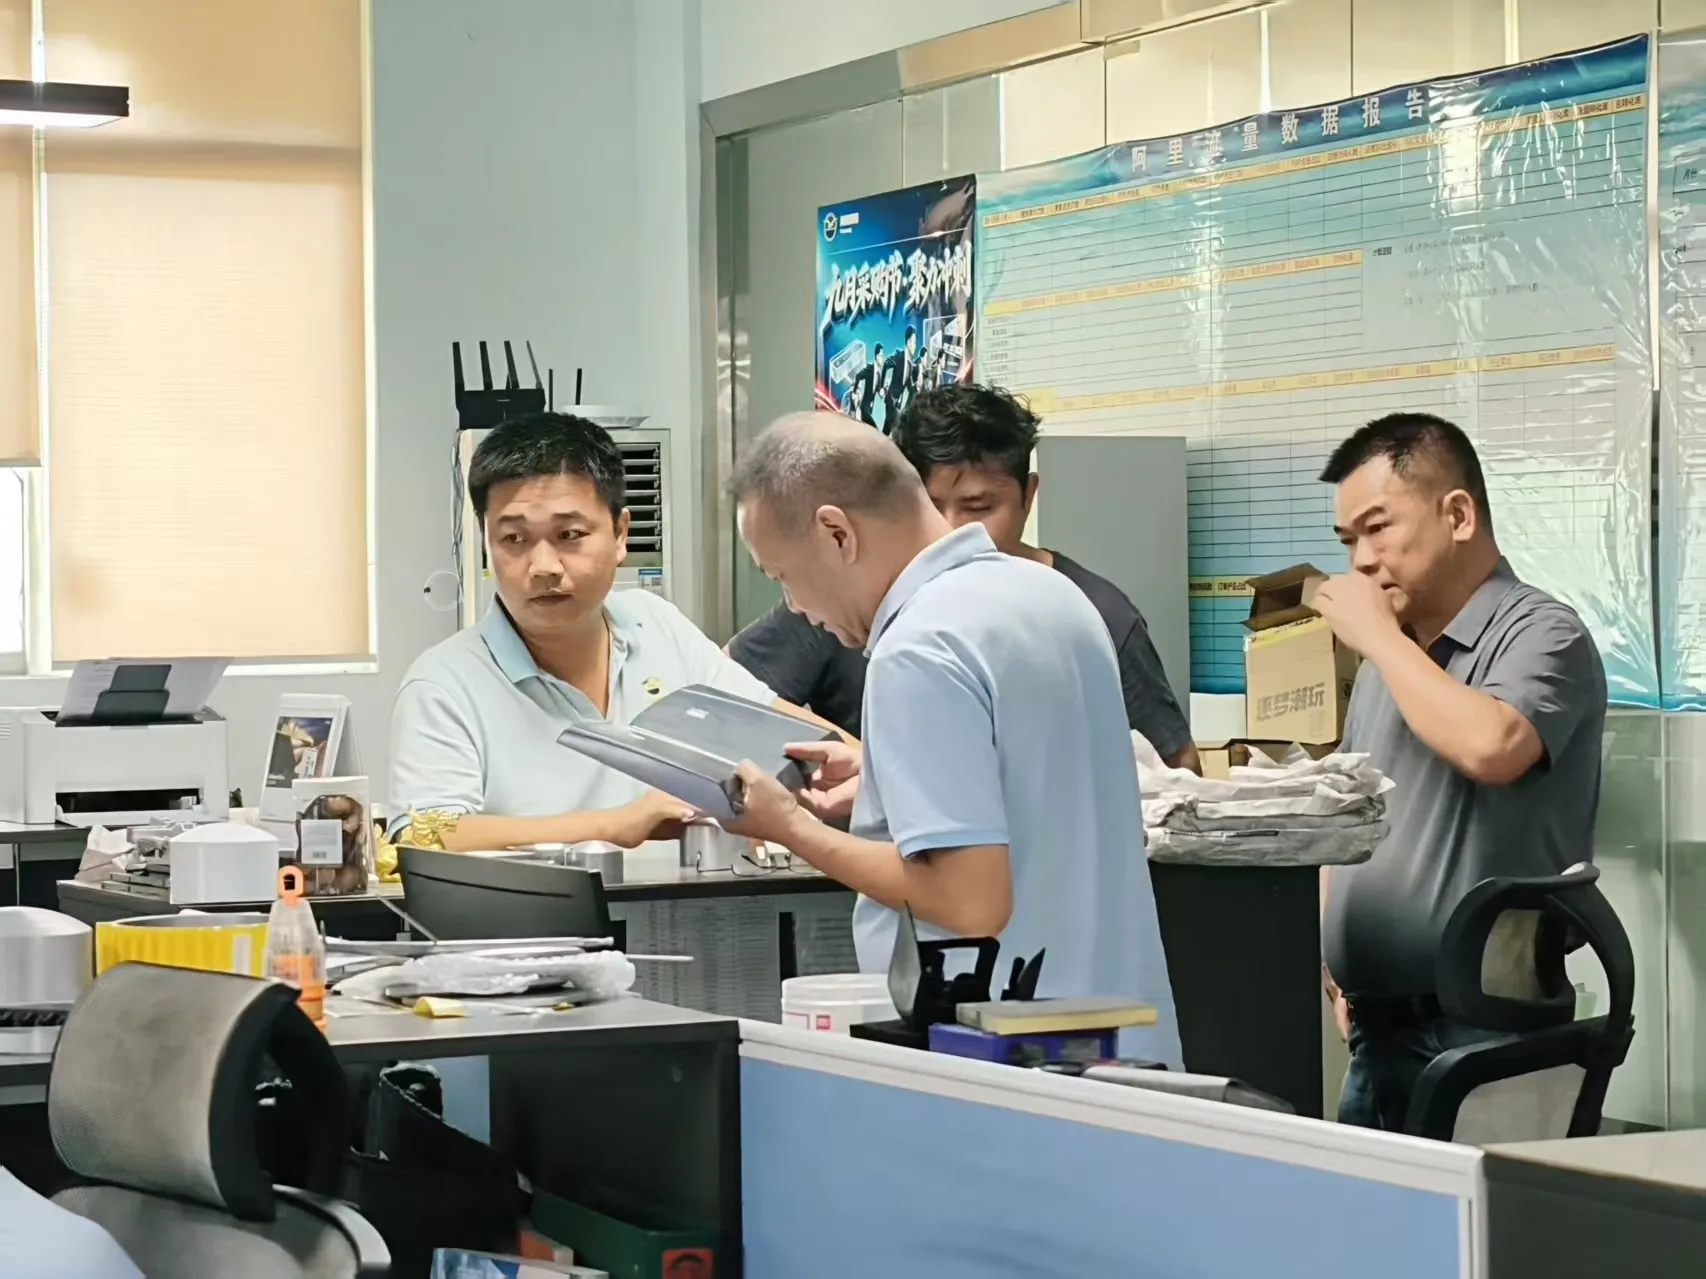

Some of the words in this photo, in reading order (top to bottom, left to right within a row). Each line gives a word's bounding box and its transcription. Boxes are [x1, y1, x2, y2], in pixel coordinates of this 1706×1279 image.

[1131, 88, 1425, 172] 阿里流量数据报告
